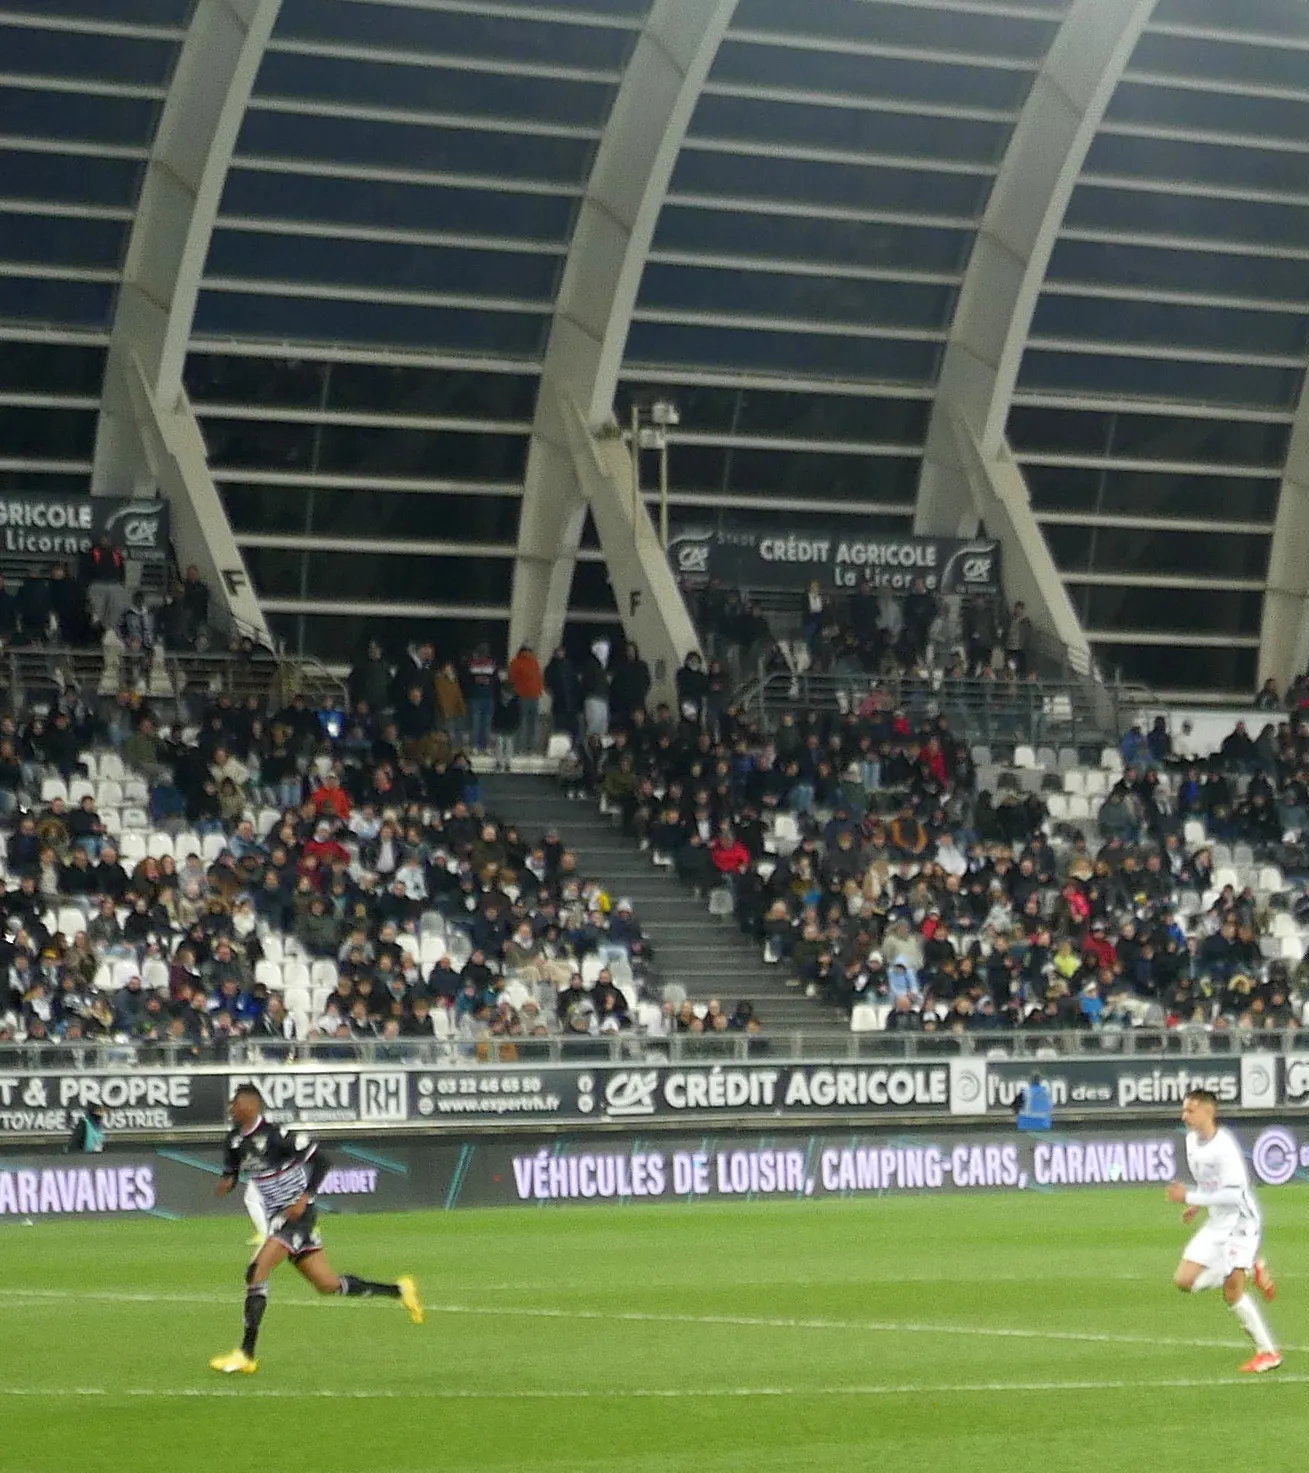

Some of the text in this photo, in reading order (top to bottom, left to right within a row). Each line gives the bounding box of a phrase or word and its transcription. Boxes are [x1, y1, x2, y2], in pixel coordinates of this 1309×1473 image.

[5, 529, 92, 553] Licorne
[759, 535, 937, 567] CRÉDIT AGRICOLE
[835, 565, 937, 590] La Licore
[24, 1077, 47, 1107] &
[60, 1076, 192, 1107] PROPRE
[366, 1078, 401, 1117] RH
[664, 1067, 948, 1108] CRÉDIT AGRICOLE
[1071, 1085, 1112, 1101] des
[512, 1142, 1177, 1199] VÉHICULES DE LOISIR, CAMPING-CARS, CARAVANES
